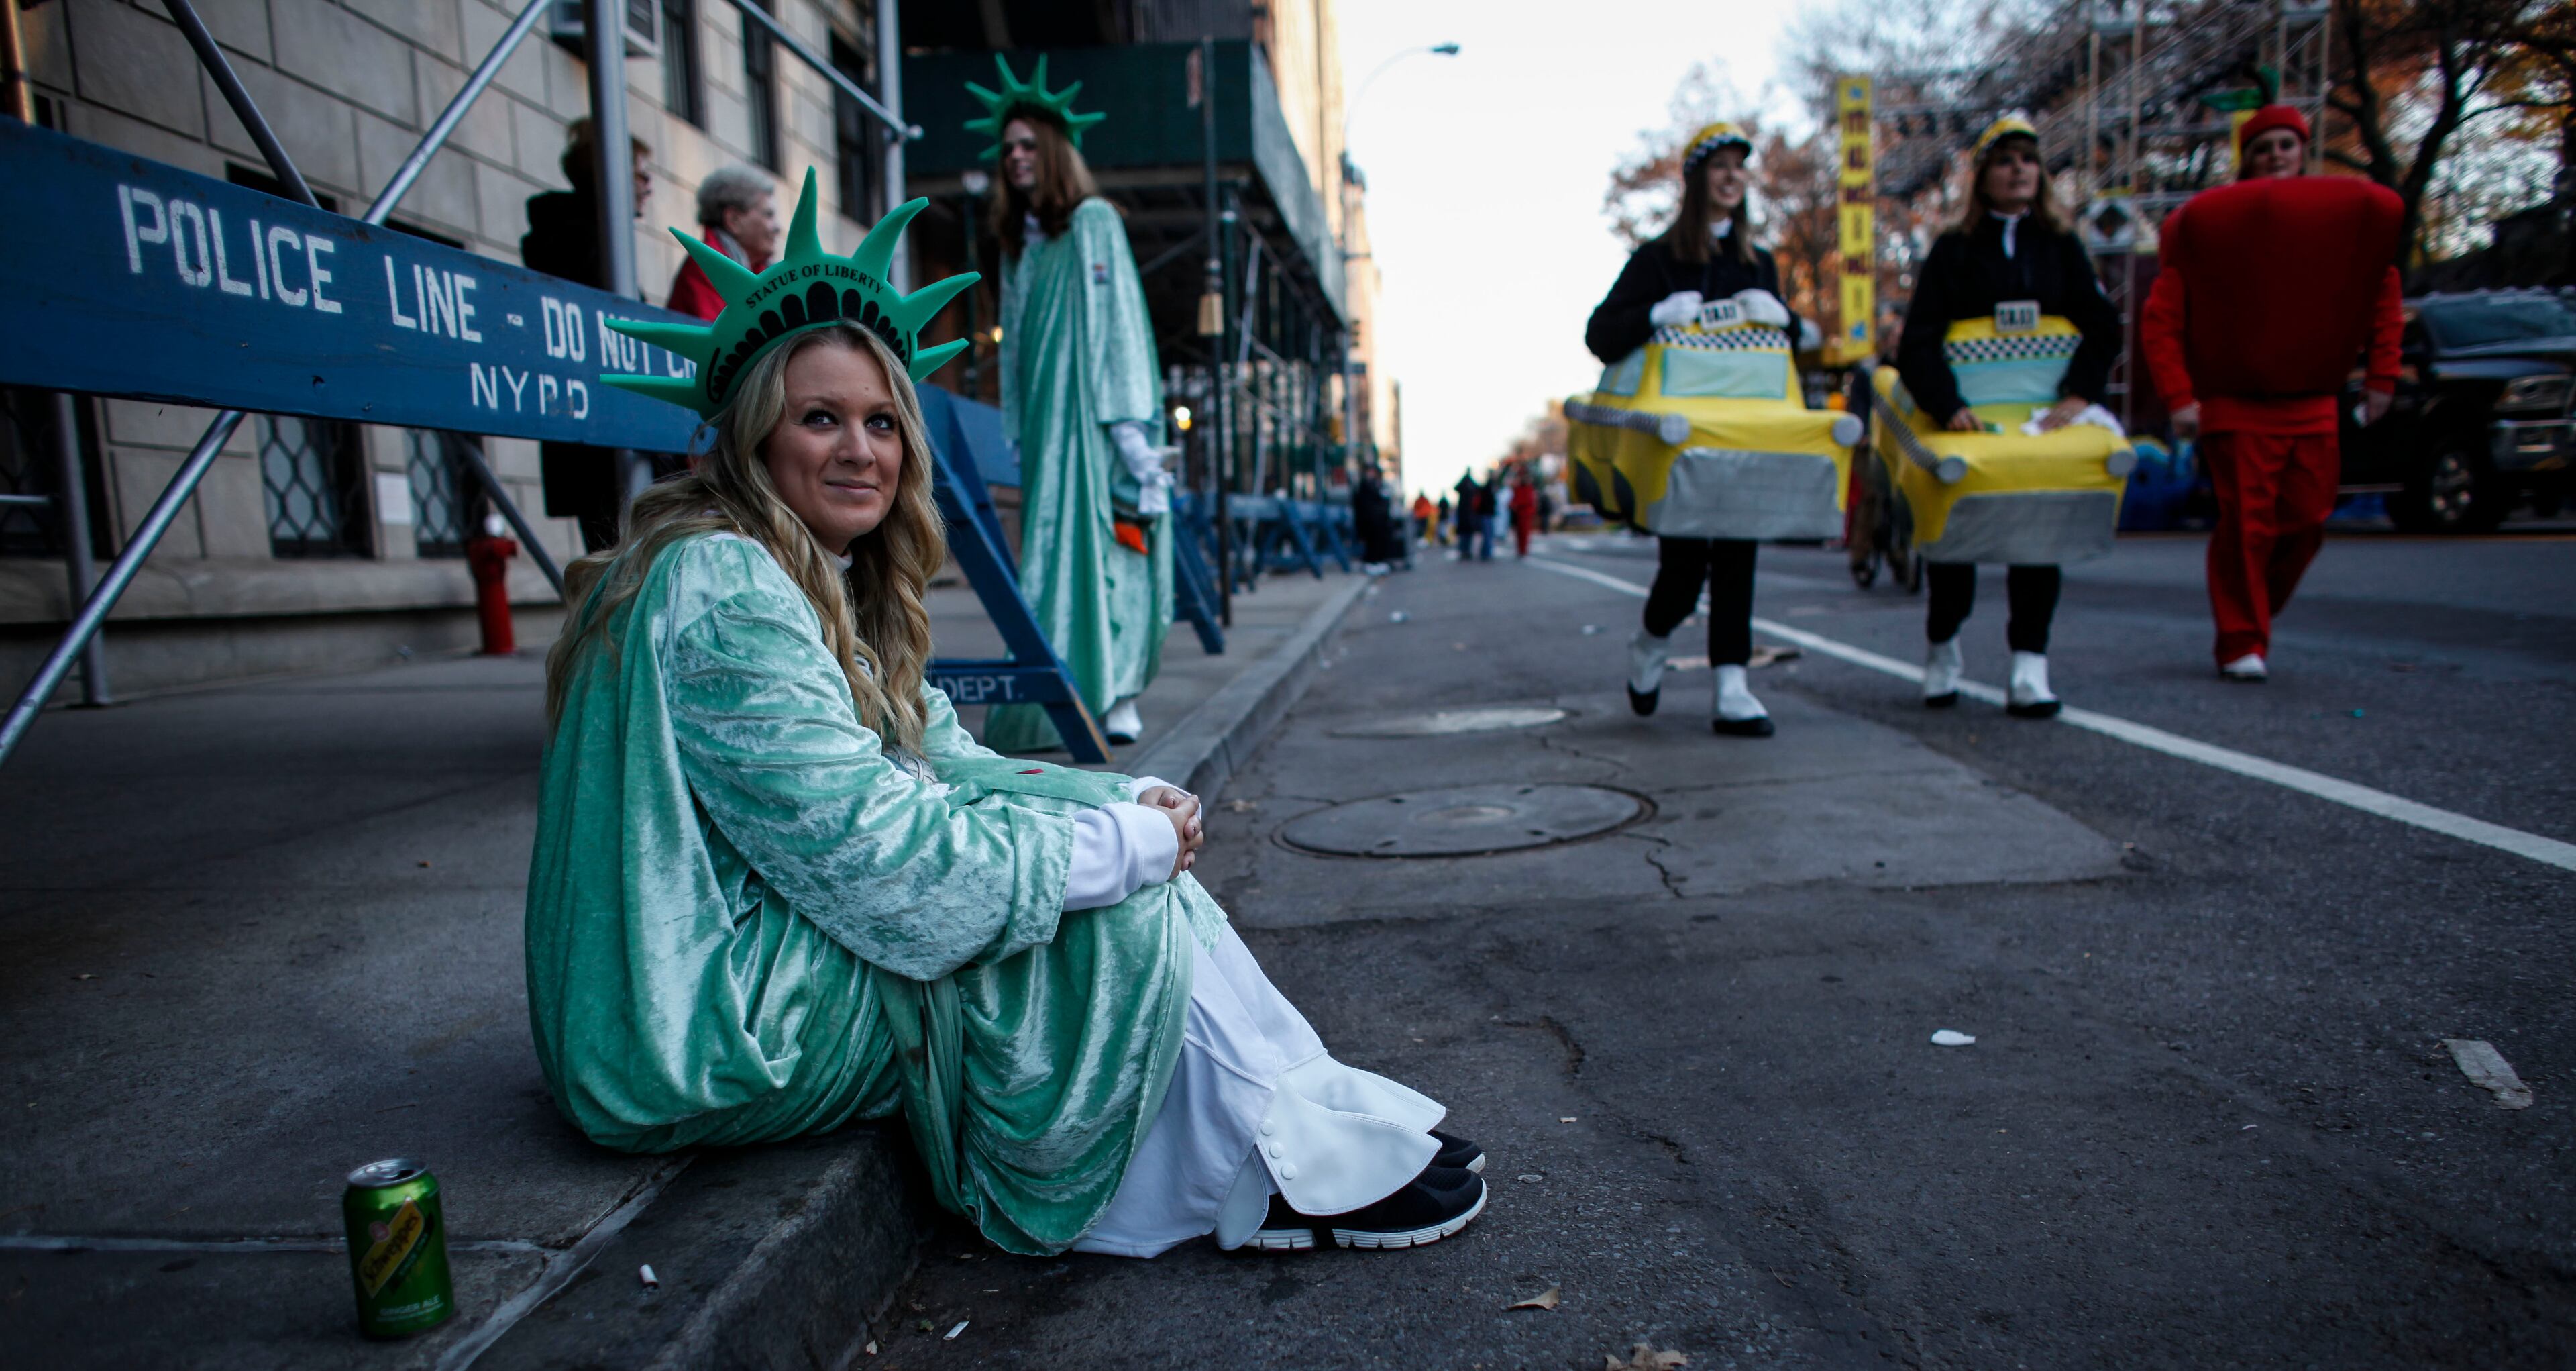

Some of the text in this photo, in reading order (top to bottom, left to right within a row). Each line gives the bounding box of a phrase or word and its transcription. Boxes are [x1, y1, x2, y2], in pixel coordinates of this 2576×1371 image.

[117, 183, 343, 314] POLICE
[384, 254, 483, 344] LINE
[541, 295, 586, 362] DO
[596, 309, 651, 376] NOT
[746, 264, 885, 309] STATUE OF LIBERTY
[470, 362, 589, 420] NYPD
[937, 675, 1024, 701] DEPT.
